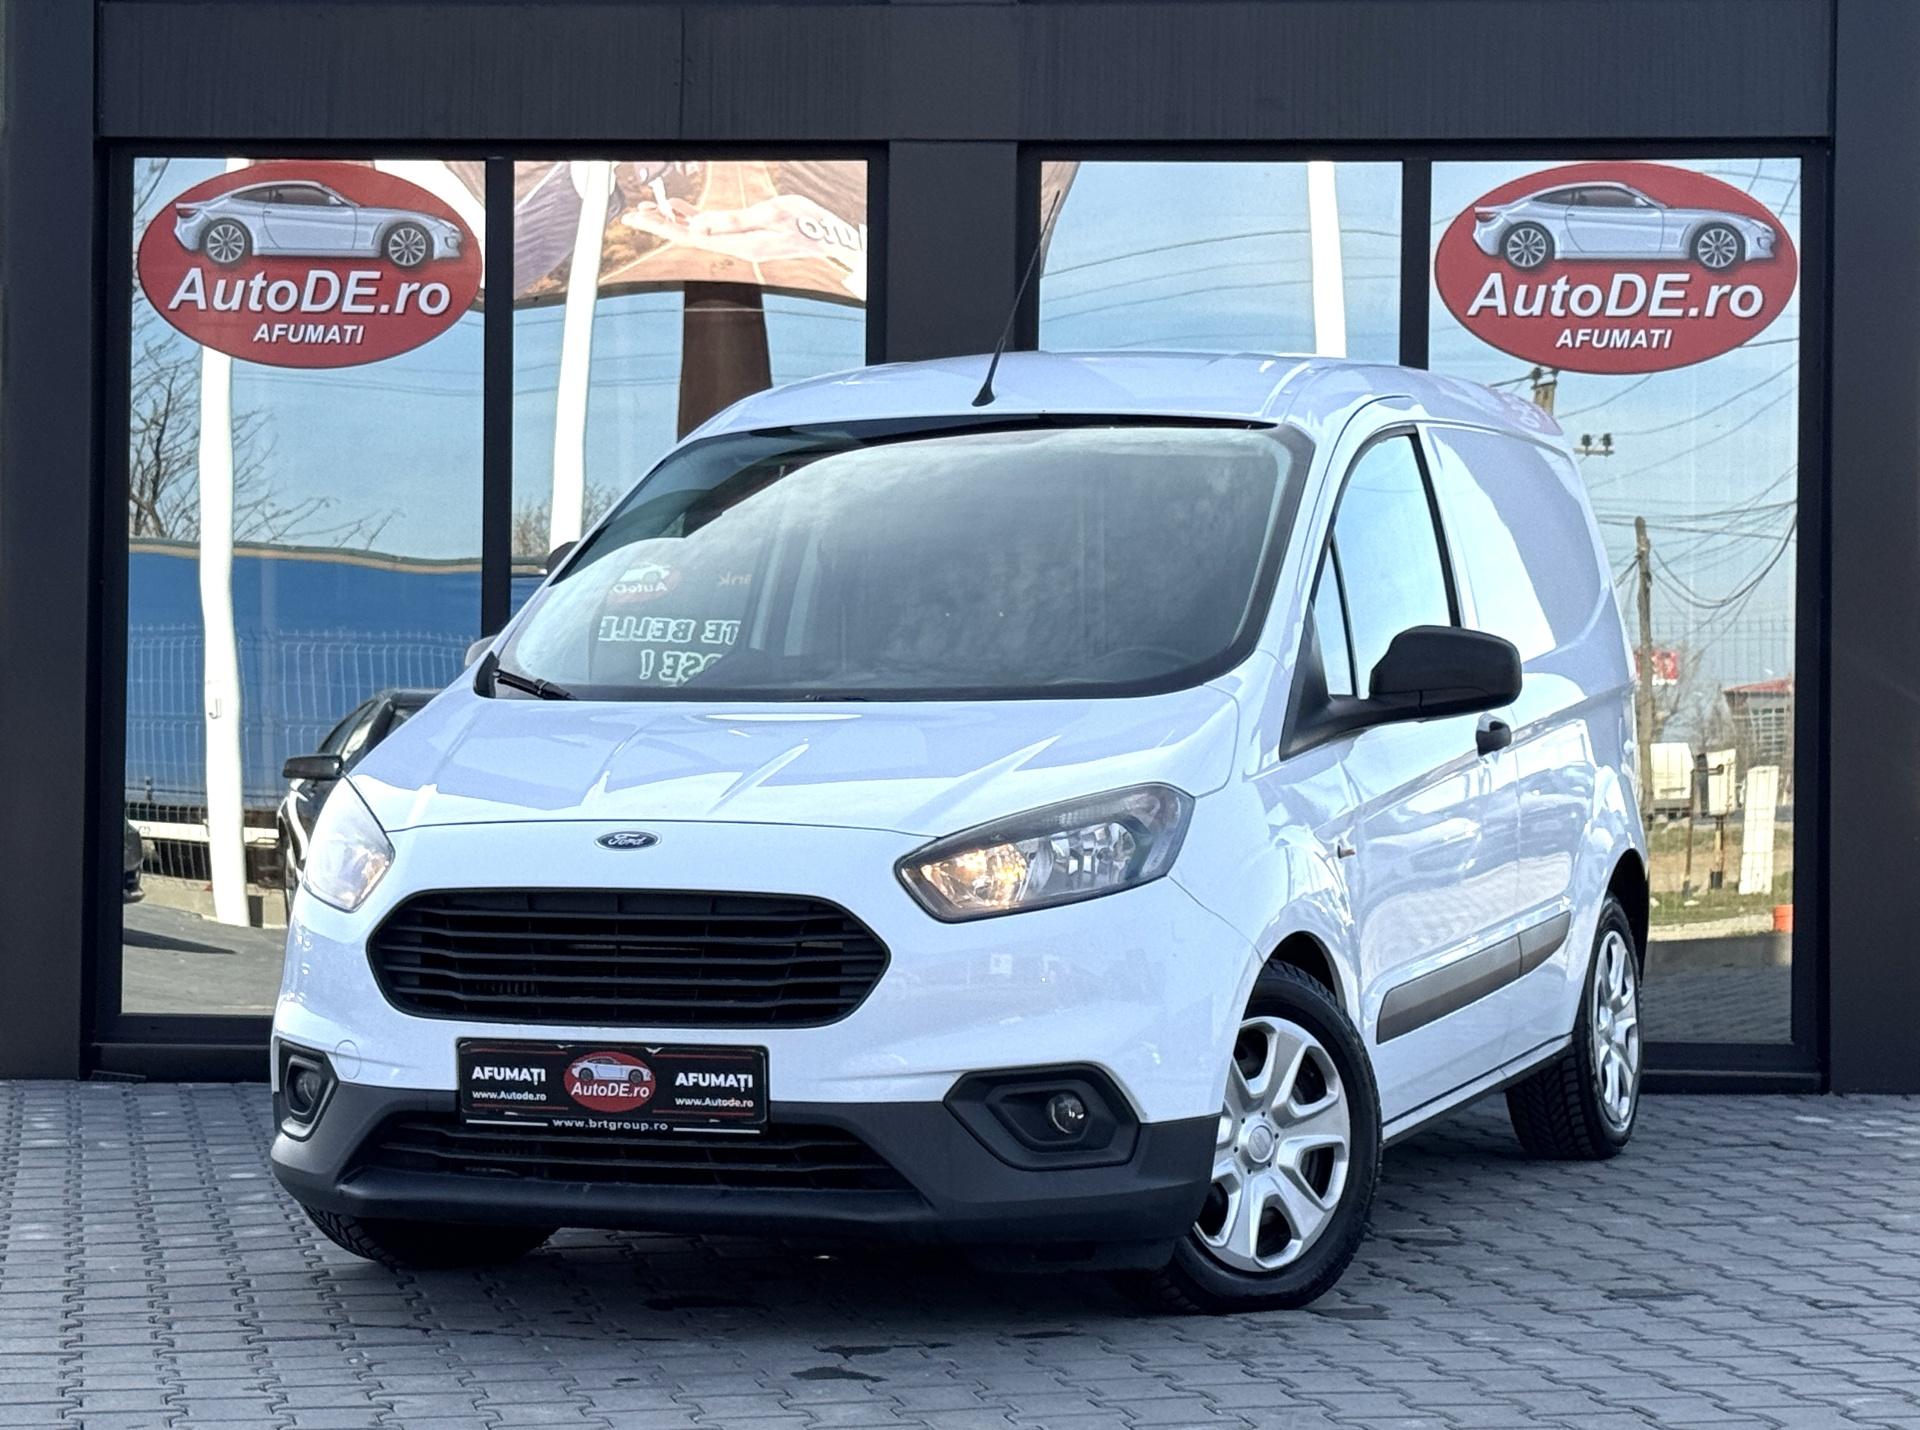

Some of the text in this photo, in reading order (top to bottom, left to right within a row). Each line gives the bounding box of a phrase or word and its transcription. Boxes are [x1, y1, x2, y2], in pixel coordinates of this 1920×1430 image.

[168, 267, 451, 315] AutoDE.ro
[1467, 272, 1764, 318] AutoDE.ro
[253, 324, 366, 345] AFUMATI
[1555, 328, 1672, 349] AFUMATI
[607, 833, 647, 845] Ford
[472, 1089, 547, 1102] www.Autode.ro
[571, 1081, 650, 1099] AutoDE.ro
[675, 1095, 754, 1108] www.Autode.ro
[552, 1117, 669, 1131] www.brtgroup.ro
